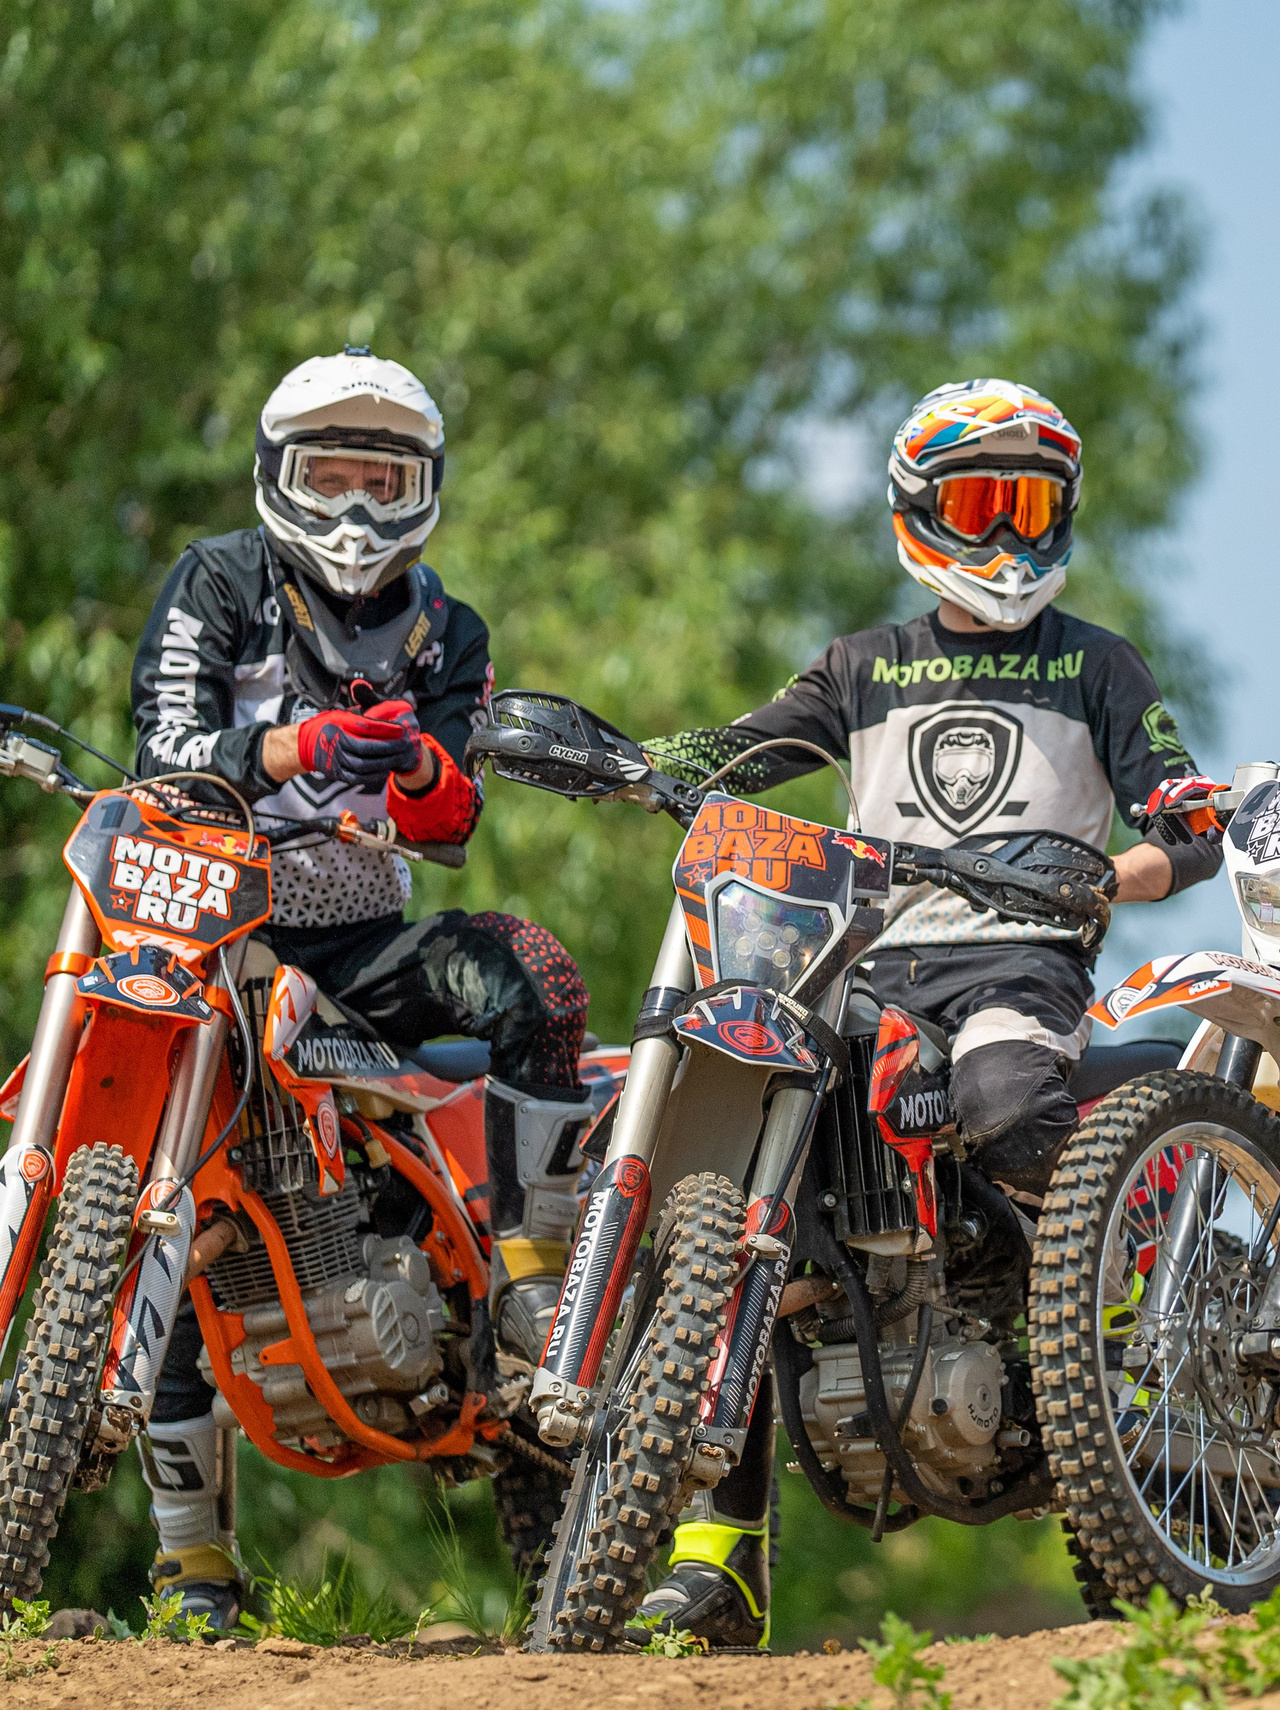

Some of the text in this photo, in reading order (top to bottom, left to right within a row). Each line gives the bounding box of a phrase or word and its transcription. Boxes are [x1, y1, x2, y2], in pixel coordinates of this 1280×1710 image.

[404, 610, 432, 659] LEATT
[550, 746, 588, 763] CYCRA
[112, 835, 238, 890] MOTO
[683, 829, 824, 868] BAZA
[112, 860, 230, 917] BAZA
[134, 892, 199, 931] RU
[111, 929, 209, 963] KTM
[1188, 979, 1220, 996] KTM
[296, 1040, 401, 1072] MOTOBAZA.RU
[545, 1190, 611, 1358] MOTOBAZA.RU
[742, 1244, 792, 1418] MOTOBAZA.RU
